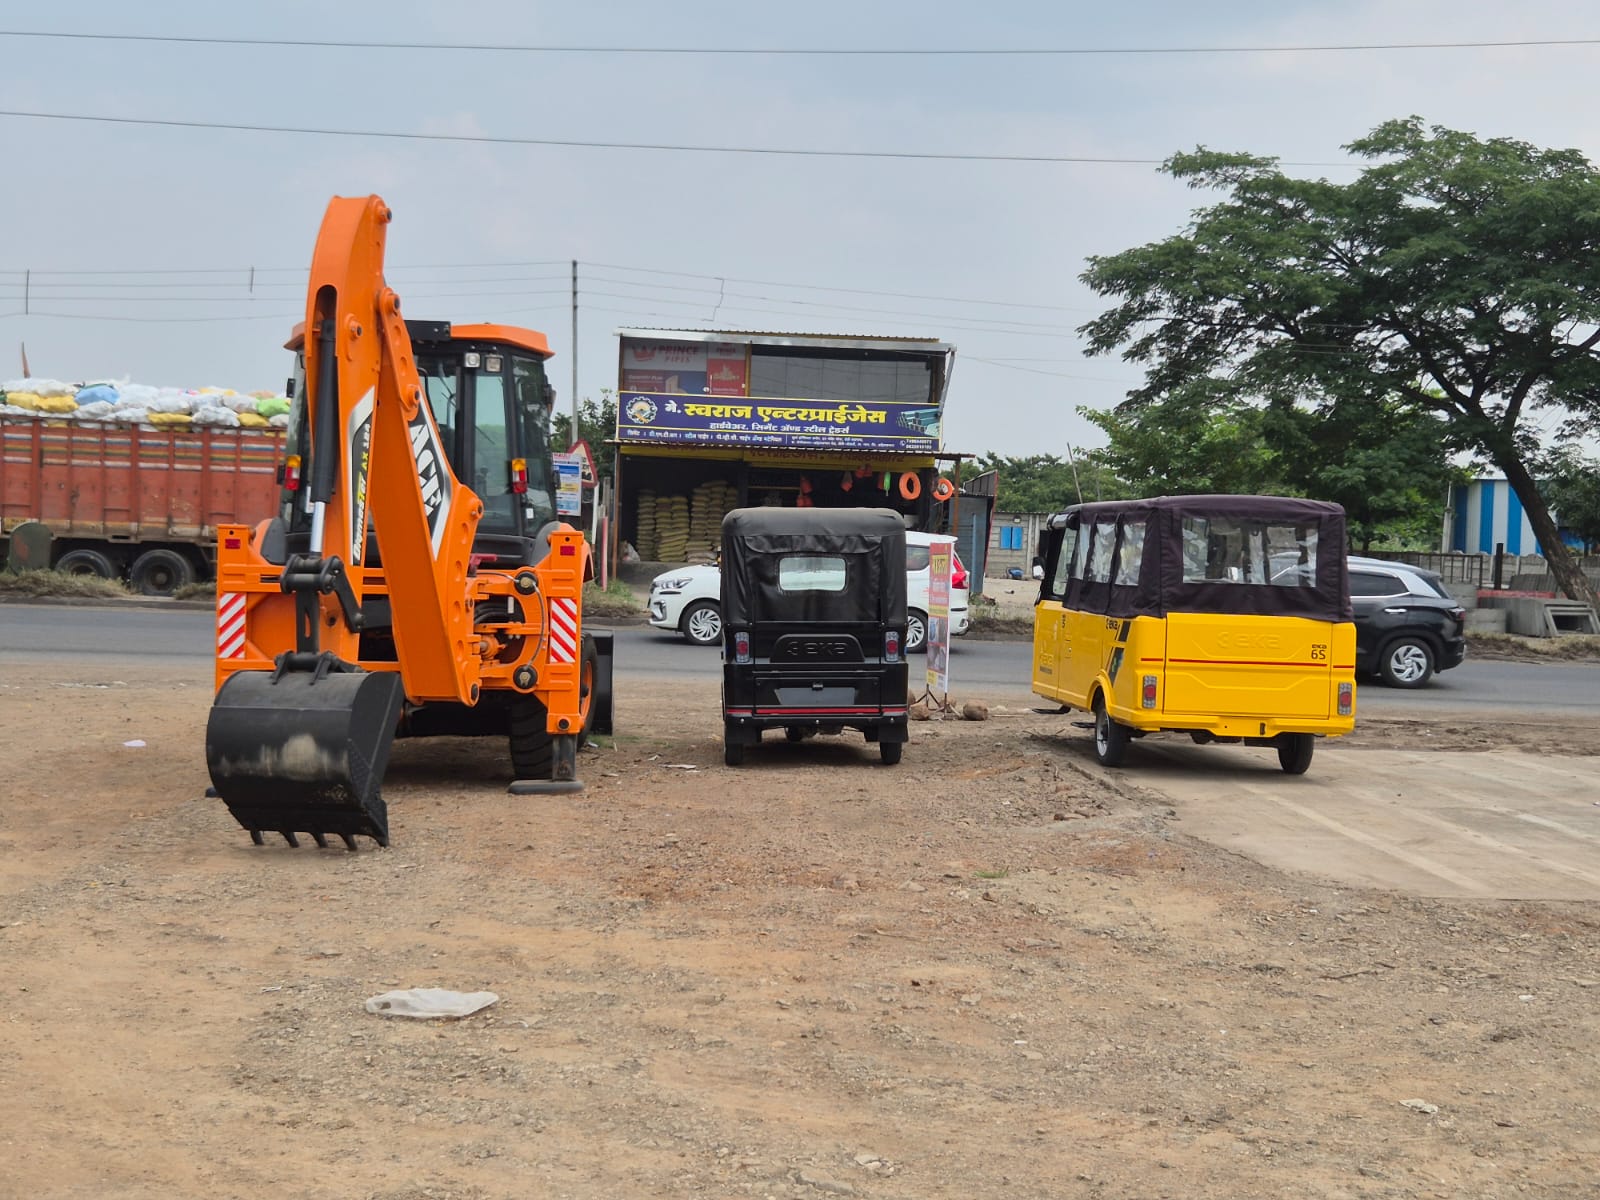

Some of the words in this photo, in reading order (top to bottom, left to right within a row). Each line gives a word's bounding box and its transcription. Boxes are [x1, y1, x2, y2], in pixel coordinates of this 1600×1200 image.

[660, 345, 699, 355] PRINCE
[683, 403, 753, 419] स्वराज
[756, 404, 887, 424] एन्टरप्राईजेस
[803, 425, 827, 433] स्टील
[1311, 649, 1326, 660] 6S
